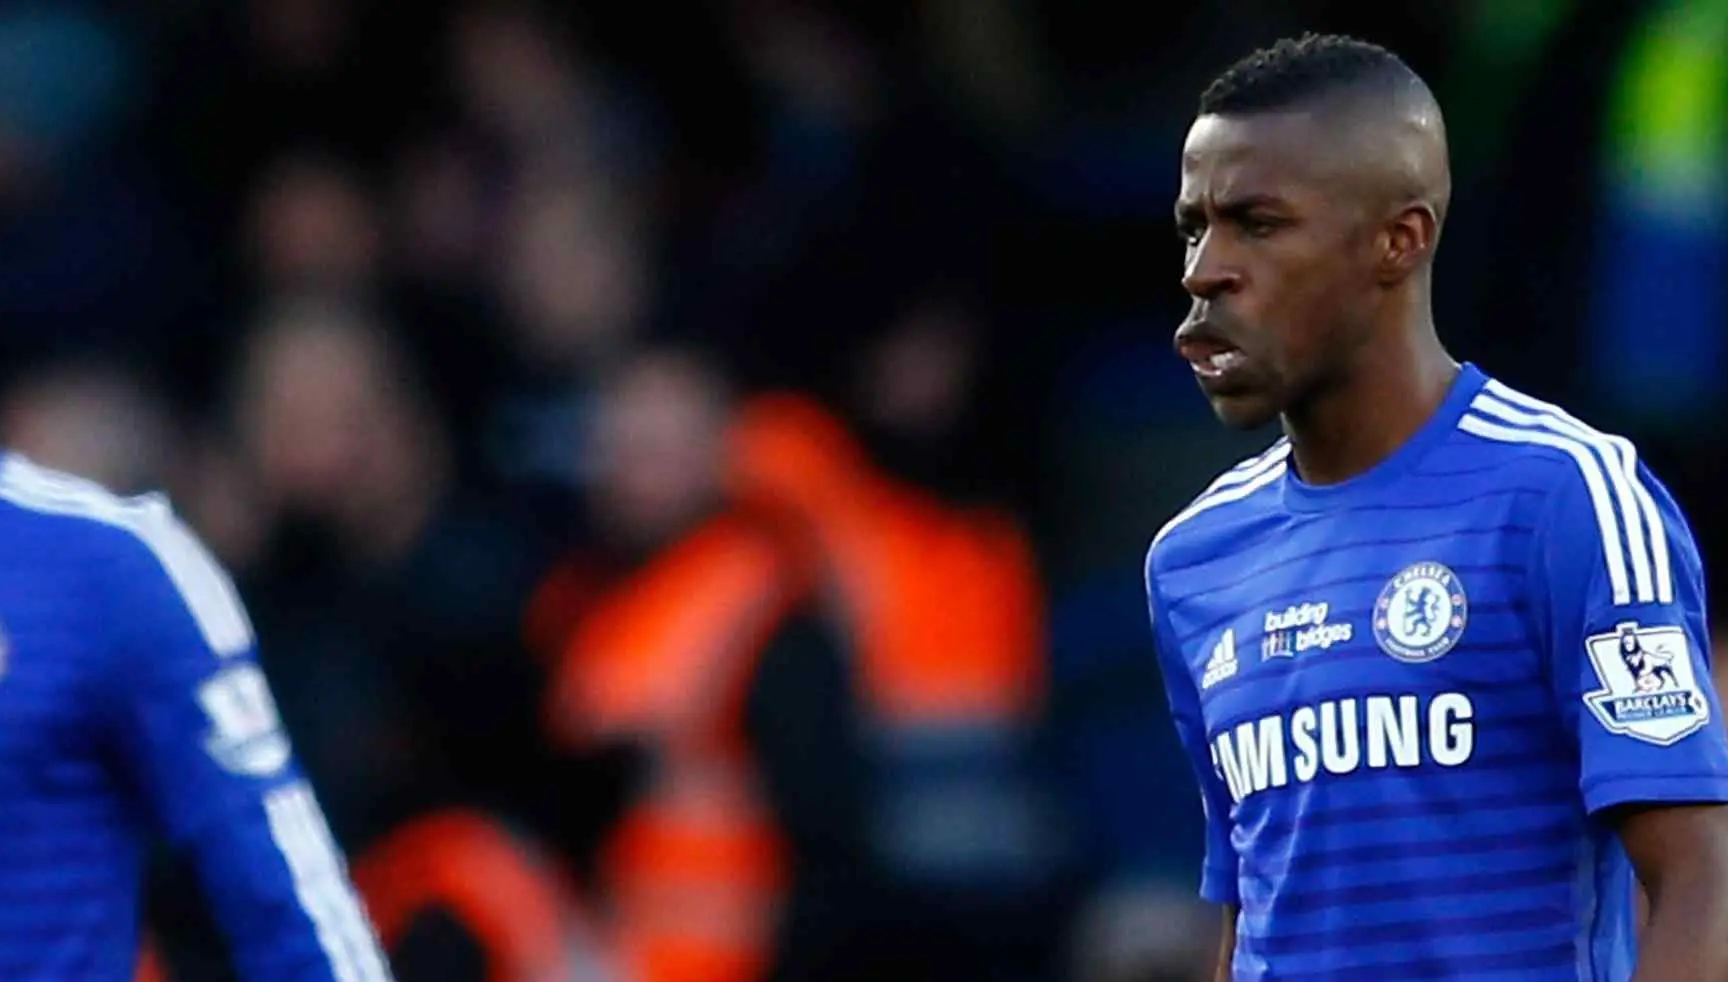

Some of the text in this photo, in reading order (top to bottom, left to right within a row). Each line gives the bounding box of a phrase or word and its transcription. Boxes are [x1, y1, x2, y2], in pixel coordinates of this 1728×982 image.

[1264, 602, 1328, 632] building
[1614, 694, 1688, 713] BARCLAYS
[1210, 693, 1473, 803] AMSUNG
